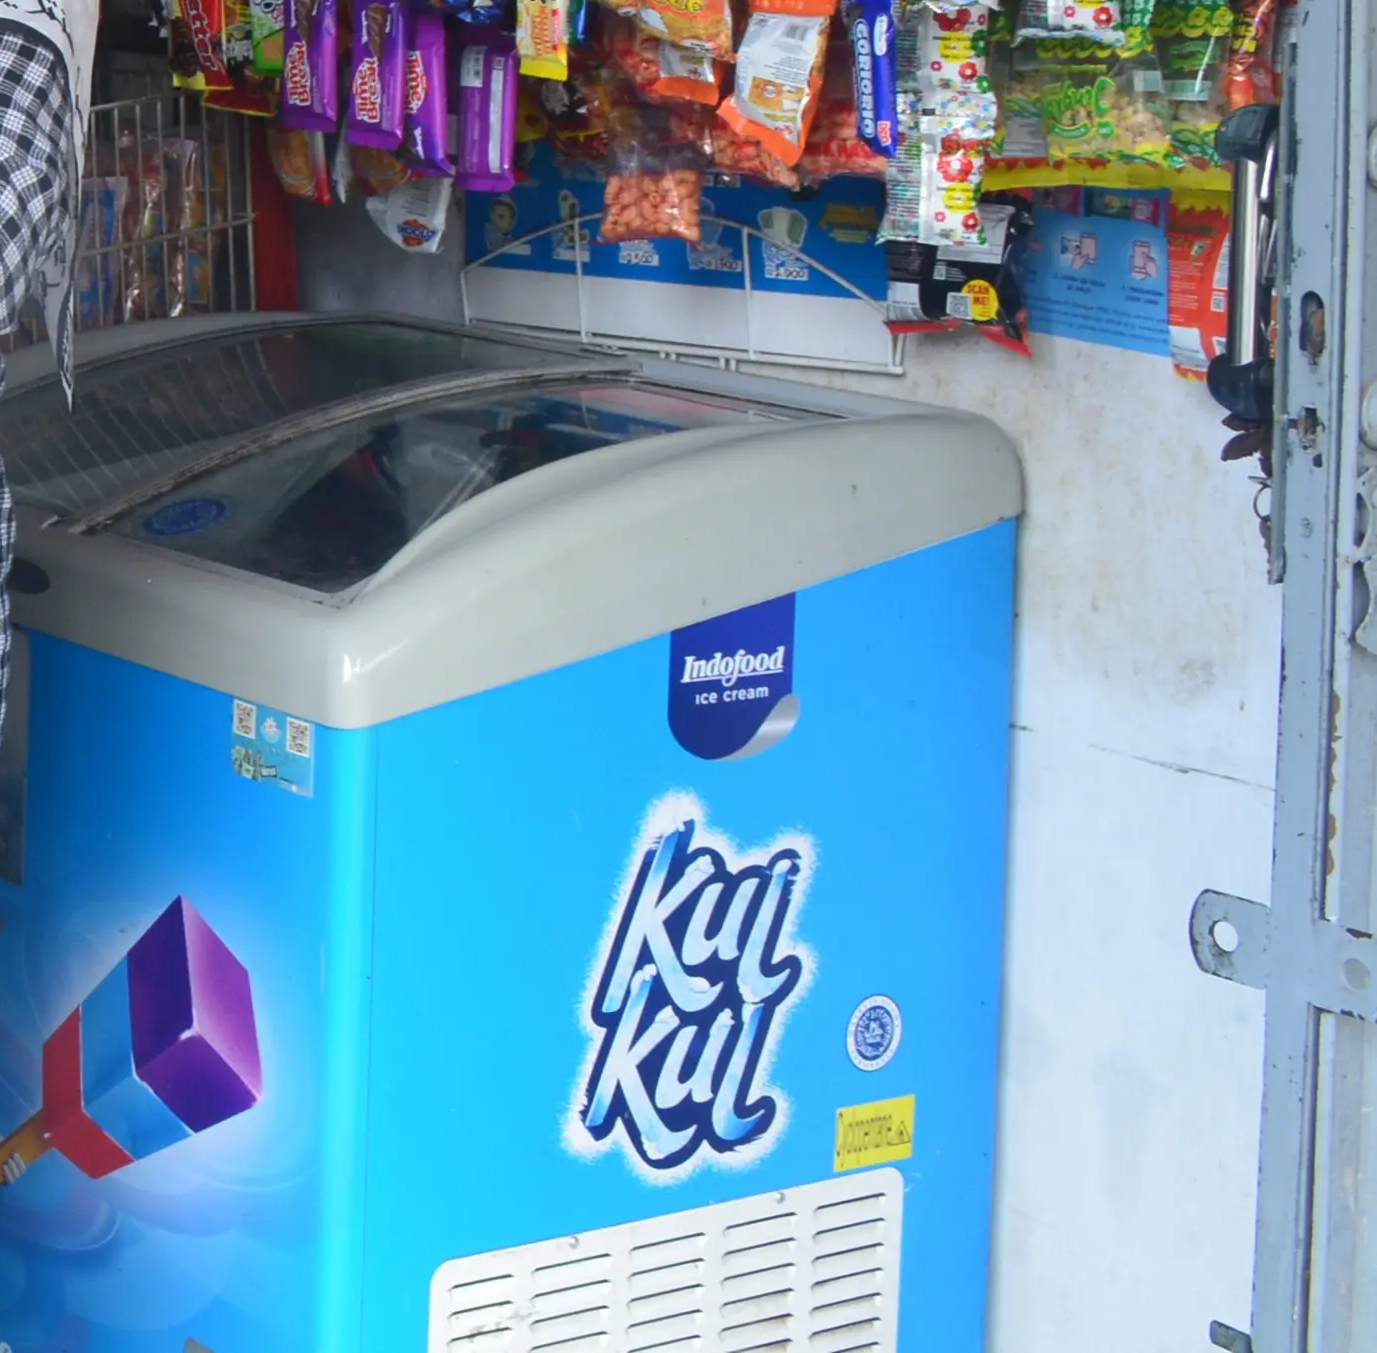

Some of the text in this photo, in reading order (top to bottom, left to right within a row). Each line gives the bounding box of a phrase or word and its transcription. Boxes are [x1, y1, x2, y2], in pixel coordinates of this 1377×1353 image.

[353, 68, 367, 121] Time
[365, 57, 381, 123] Break
[853, 18, 876, 140] GORIORIO
[965, 283, 992, 297] SCAN
[680, 644, 785, 689] Indofood
[723, 683, 770, 703] cream
[598, 818, 802, 1014] Kul
[580, 964, 777, 1170] Kul
